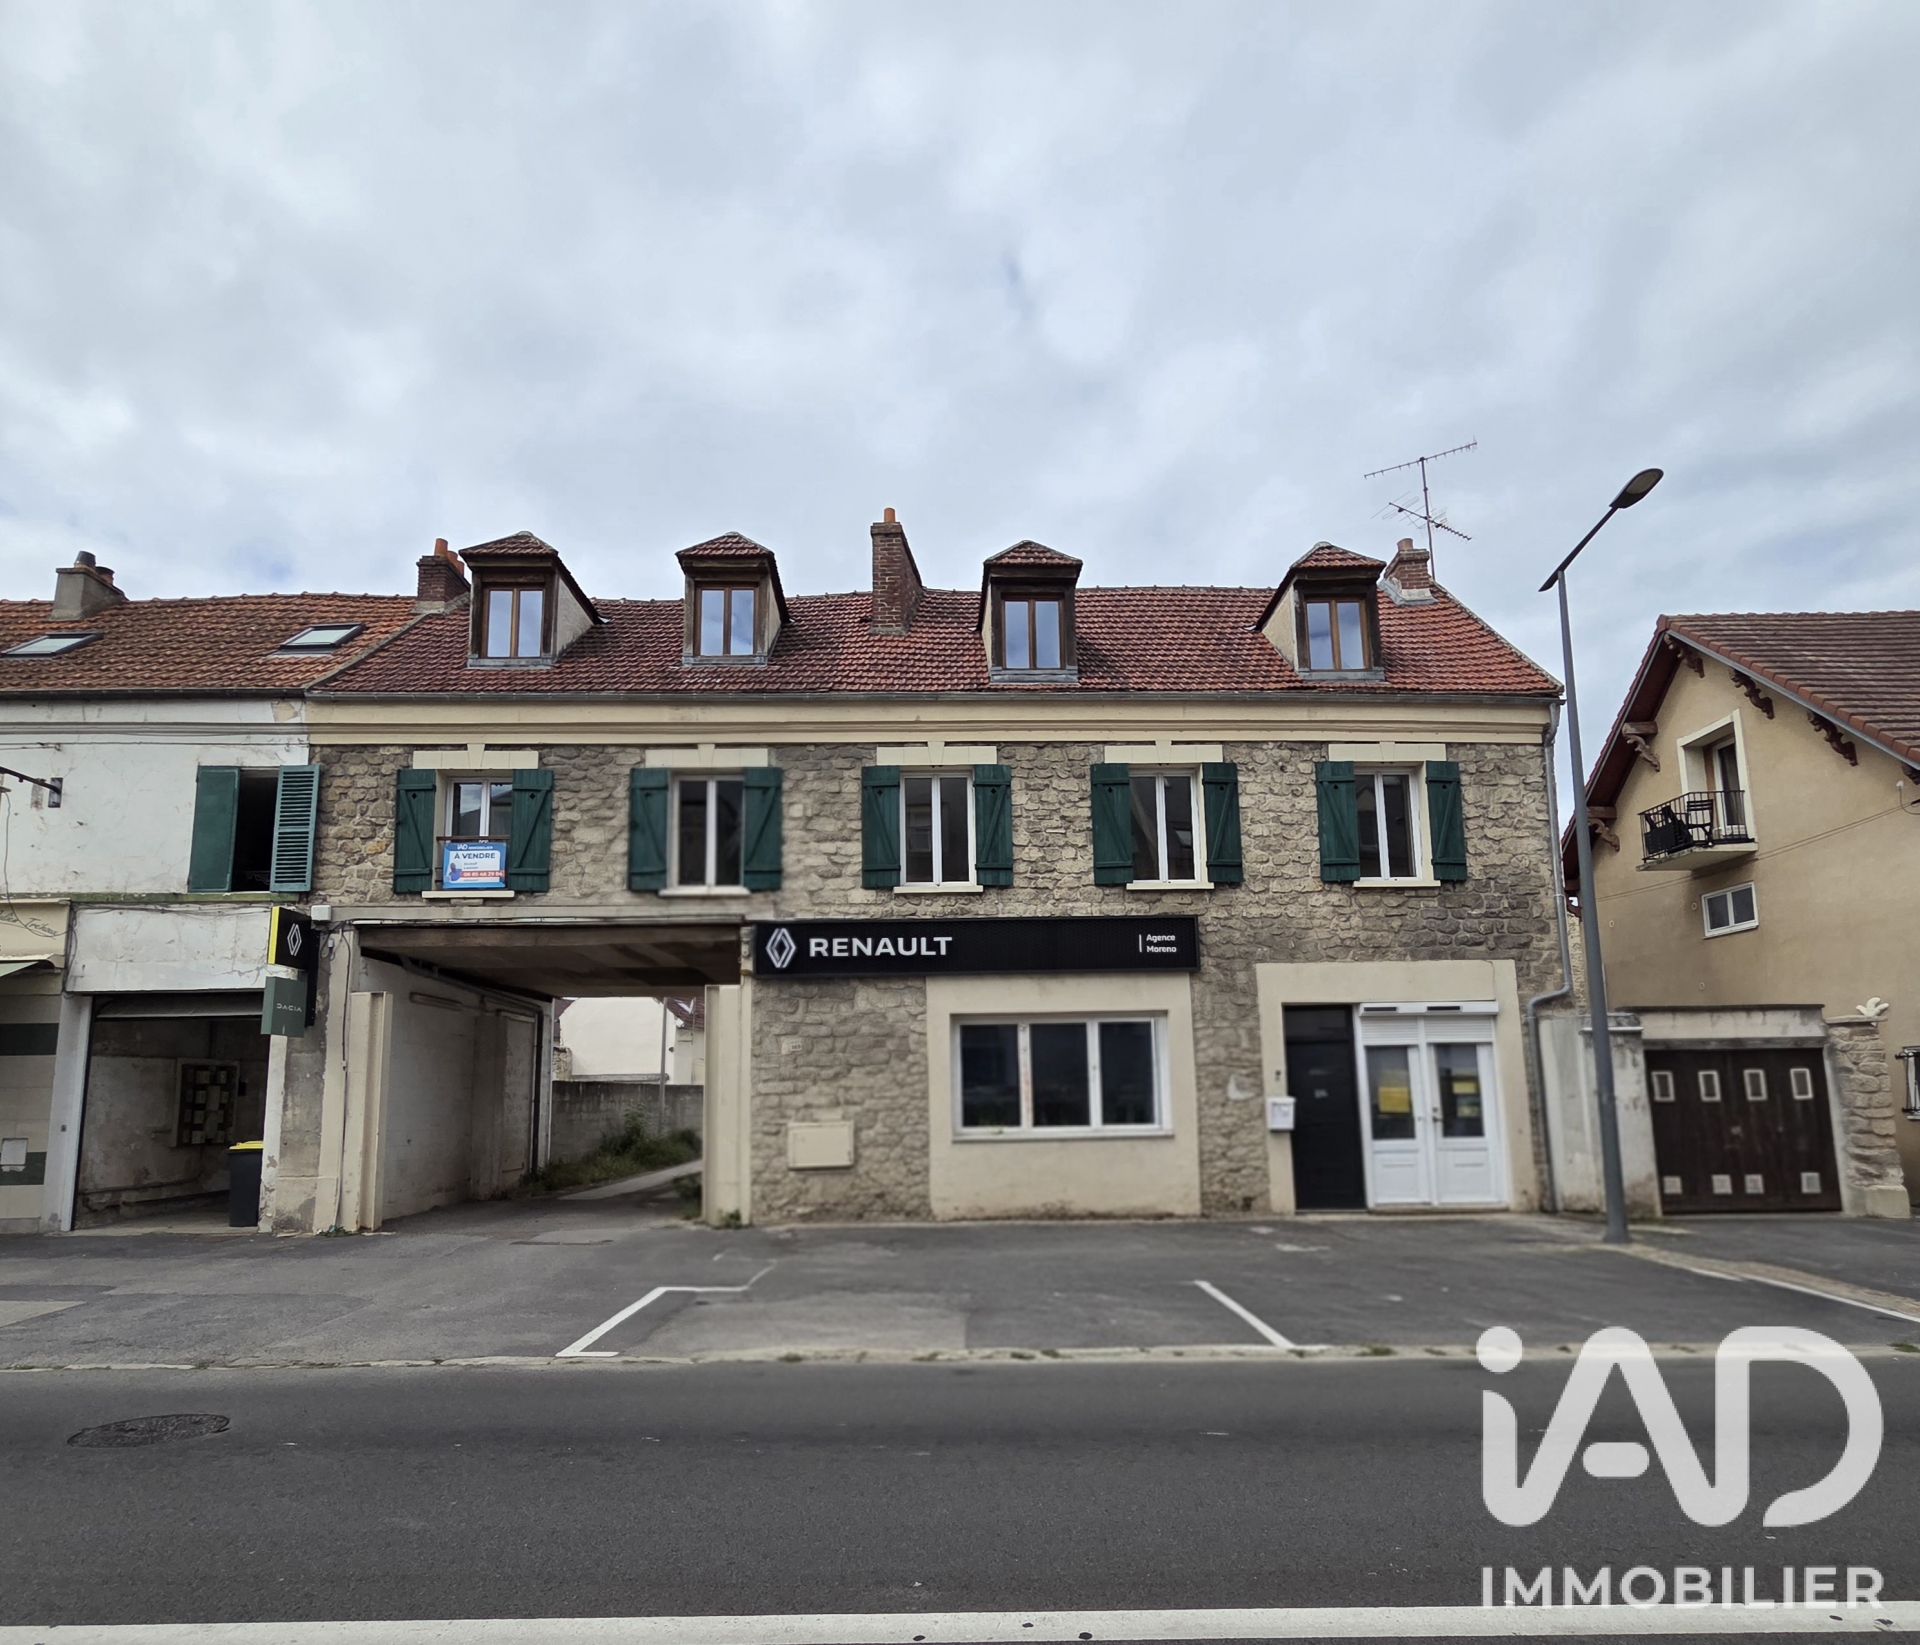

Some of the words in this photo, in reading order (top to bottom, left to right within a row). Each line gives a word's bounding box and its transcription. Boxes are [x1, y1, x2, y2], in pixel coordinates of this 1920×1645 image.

[1146, 934, 1176, 943] Agence
[809, 936, 953, 957] RENAULT
[1146, 945, 1177, 953] Moreno
[276, 1003, 302, 1012] DACIA
